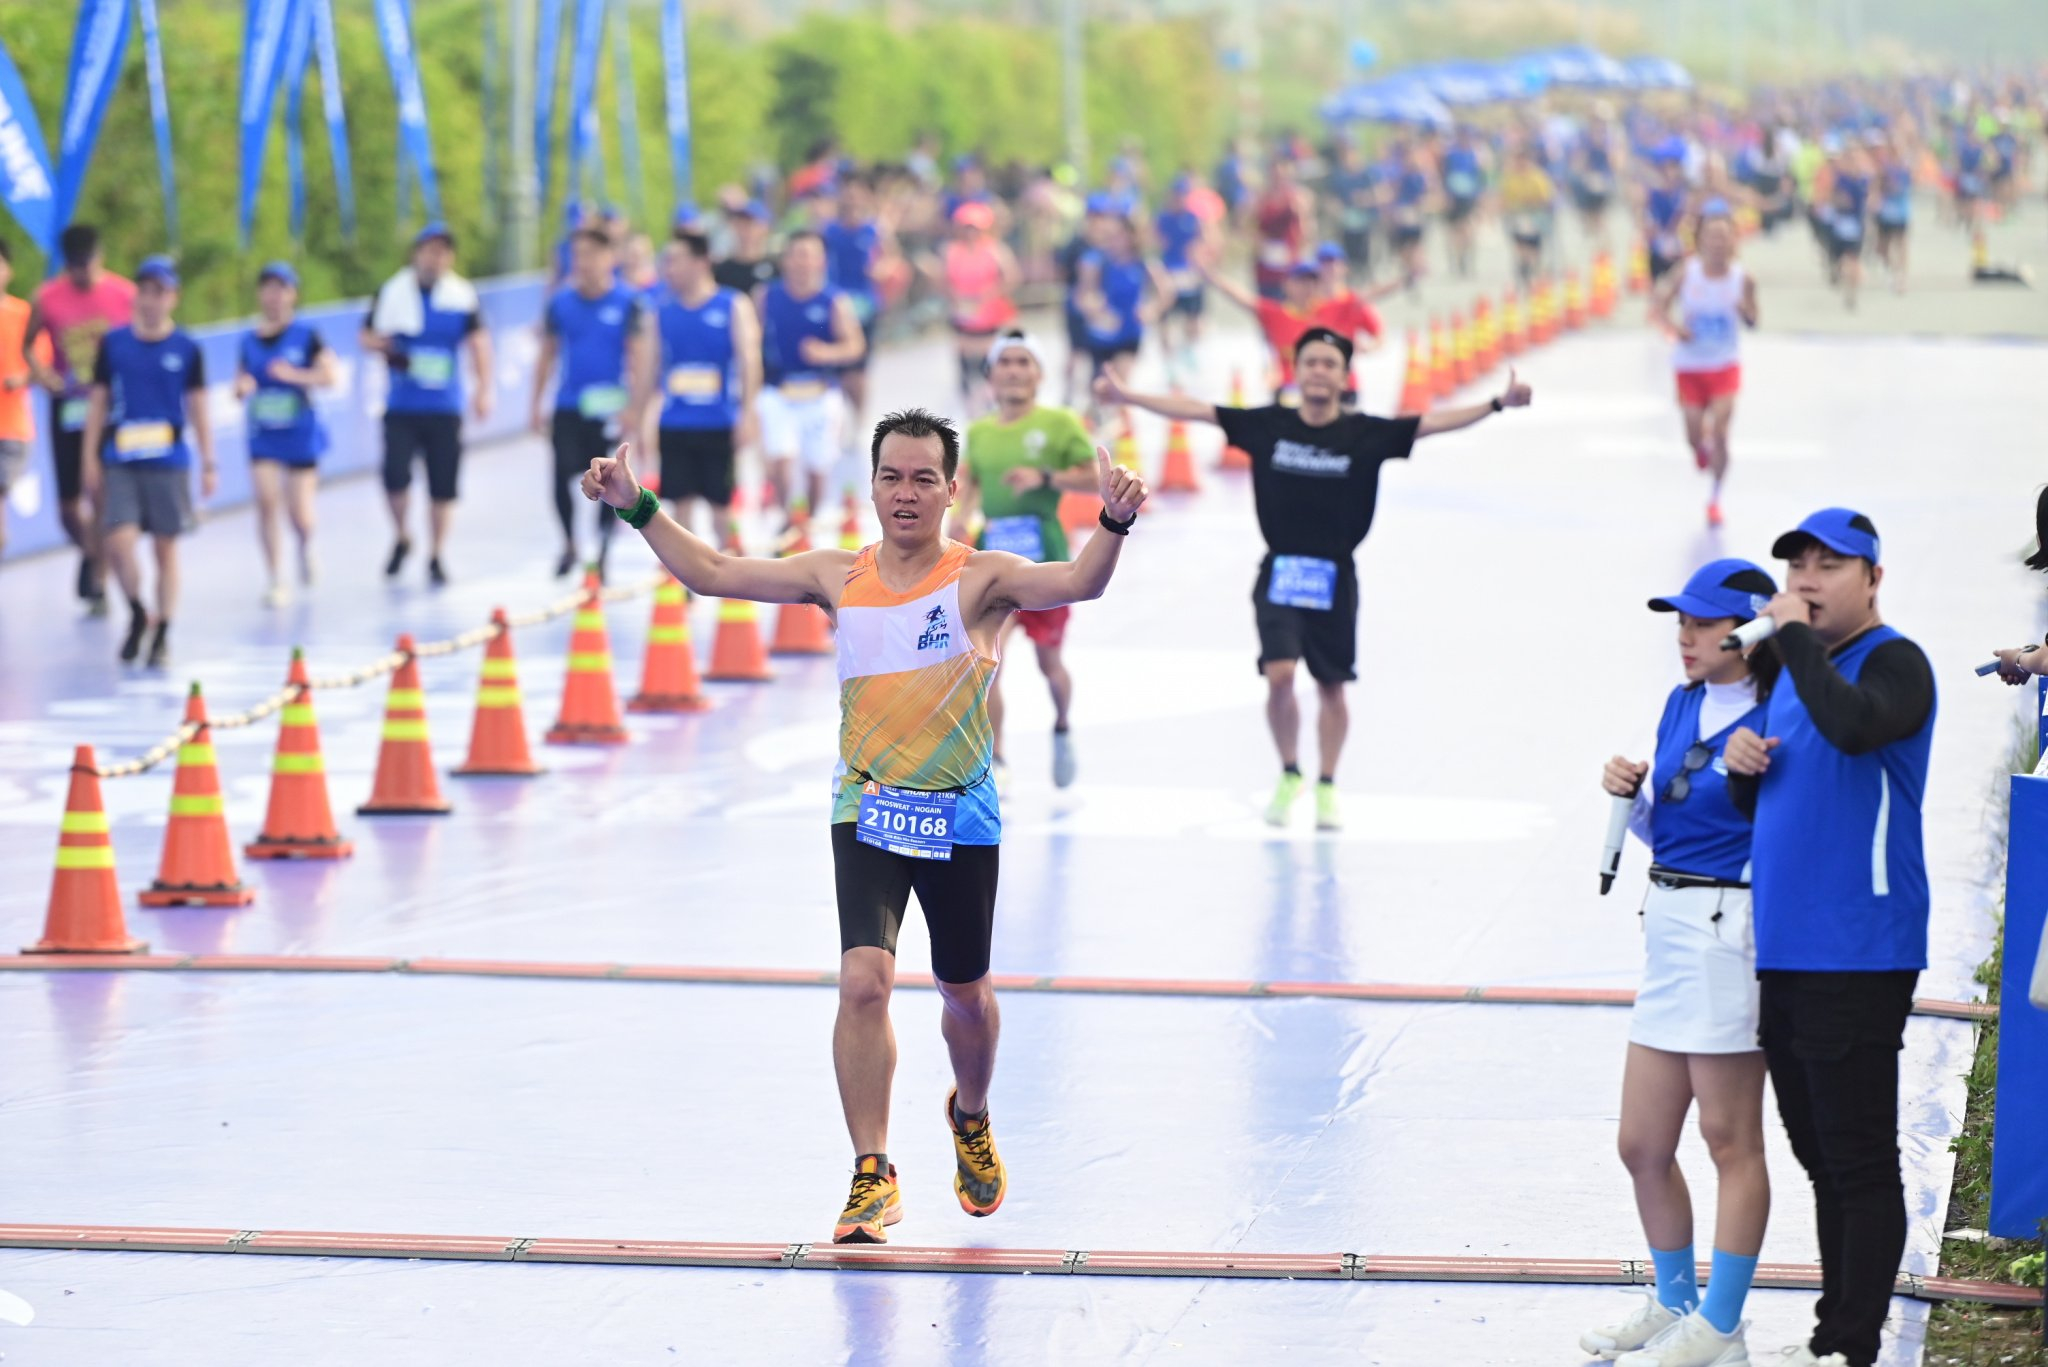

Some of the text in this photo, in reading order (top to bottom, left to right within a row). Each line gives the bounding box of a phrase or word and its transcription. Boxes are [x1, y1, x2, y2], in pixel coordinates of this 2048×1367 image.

[918, 633, 950, 650] BHR
[866, 781, 876, 793] A
[937, 792, 956, 800] 21KM
[875, 799, 910, 811] #NOSWEAT
[914, 806, 942, 815] NOGAIN
[864, 808, 947, 836] 210168
